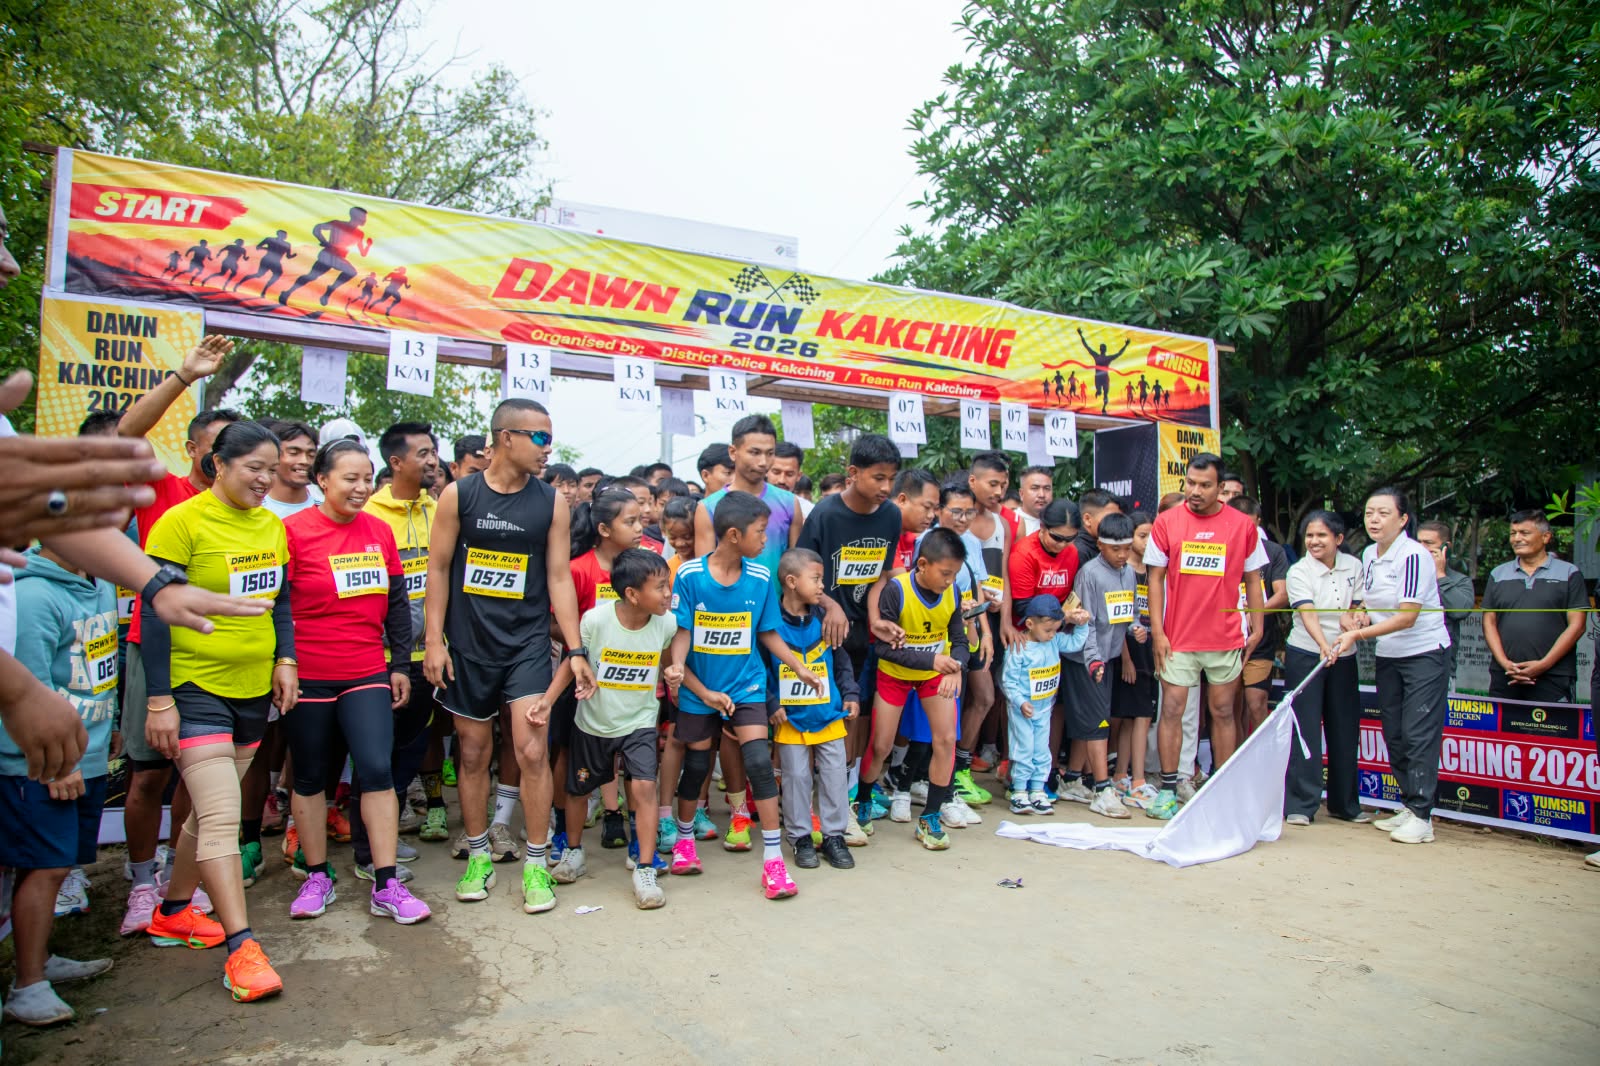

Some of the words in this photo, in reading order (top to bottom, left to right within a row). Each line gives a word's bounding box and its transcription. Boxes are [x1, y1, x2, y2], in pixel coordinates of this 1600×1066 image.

[95, 191, 212, 224] START
[491, 257, 680, 315] DAWN
[682, 289, 804, 335] RUN
[815, 310, 1016, 369] KAKCHING
[87, 310, 158, 338] DAWN
[95, 338, 142, 363] RUN
[403, 340, 425, 357] 13
[730, 332, 819, 358] 2026
[520, 352, 540, 368] 13
[531, 329, 616, 353] Organised
[620, 340, 645, 357] by:
[662, 346, 718, 365] District
[721, 352, 767, 370] Police
[771, 361, 835, 381] Kakching
[860, 373, 895, 388] Team
[898, 376, 922, 391] Run
[925, 380, 982, 398] Kakching
[1154, 351, 1202, 378] FINISH
[394, 365, 430, 382] K/M
[626, 364, 644, 379] 13
[513, 376, 545, 392] K/M
[720, 376, 737, 390] 13
[88, 390, 145, 412] 202
[620, 388, 650, 401] K/M
[716, 398, 744, 411] K/M
[898, 400, 914, 413] 07
[968, 406, 981, 420] 07
[1008, 409, 1021, 422] 07
[895, 421, 921, 432] K/M
[1052, 417, 1067, 430] 07
[965, 427, 987, 440] K/M
[1005, 429, 1026, 442] K/M
[1177, 430, 1204, 445] DAWN
[1050, 436, 1073, 448] K/M
[231, 554, 259, 565] DAWN
[262, 552, 275, 560] RUN
[334, 556, 360, 564] DAWN
[470, 552, 499, 560] DAWN
[501, 555, 522, 563] RUN
[1186, 556, 1220, 568] 0385
[844, 563, 878, 576] 0468
[242, 570, 276, 592] 1503
[346, 571, 380, 587] 1504
[471, 569, 517, 588] 0575
[88, 637, 110, 652] DAWN
[703, 631, 742, 645] 1502
[604, 651, 633, 659] DAWN
[603, 666, 649, 682] 0554
[1448, 700, 1494, 714] YUMSHA
[1449, 712, 1481, 721] CHICKEN
[1529, 747, 1600, 790] 2026
[1532, 794, 1585, 815] YUMSHA
[1534, 809, 1572, 820] CHICKEN
[1535, 816, 1550, 825] EGG
